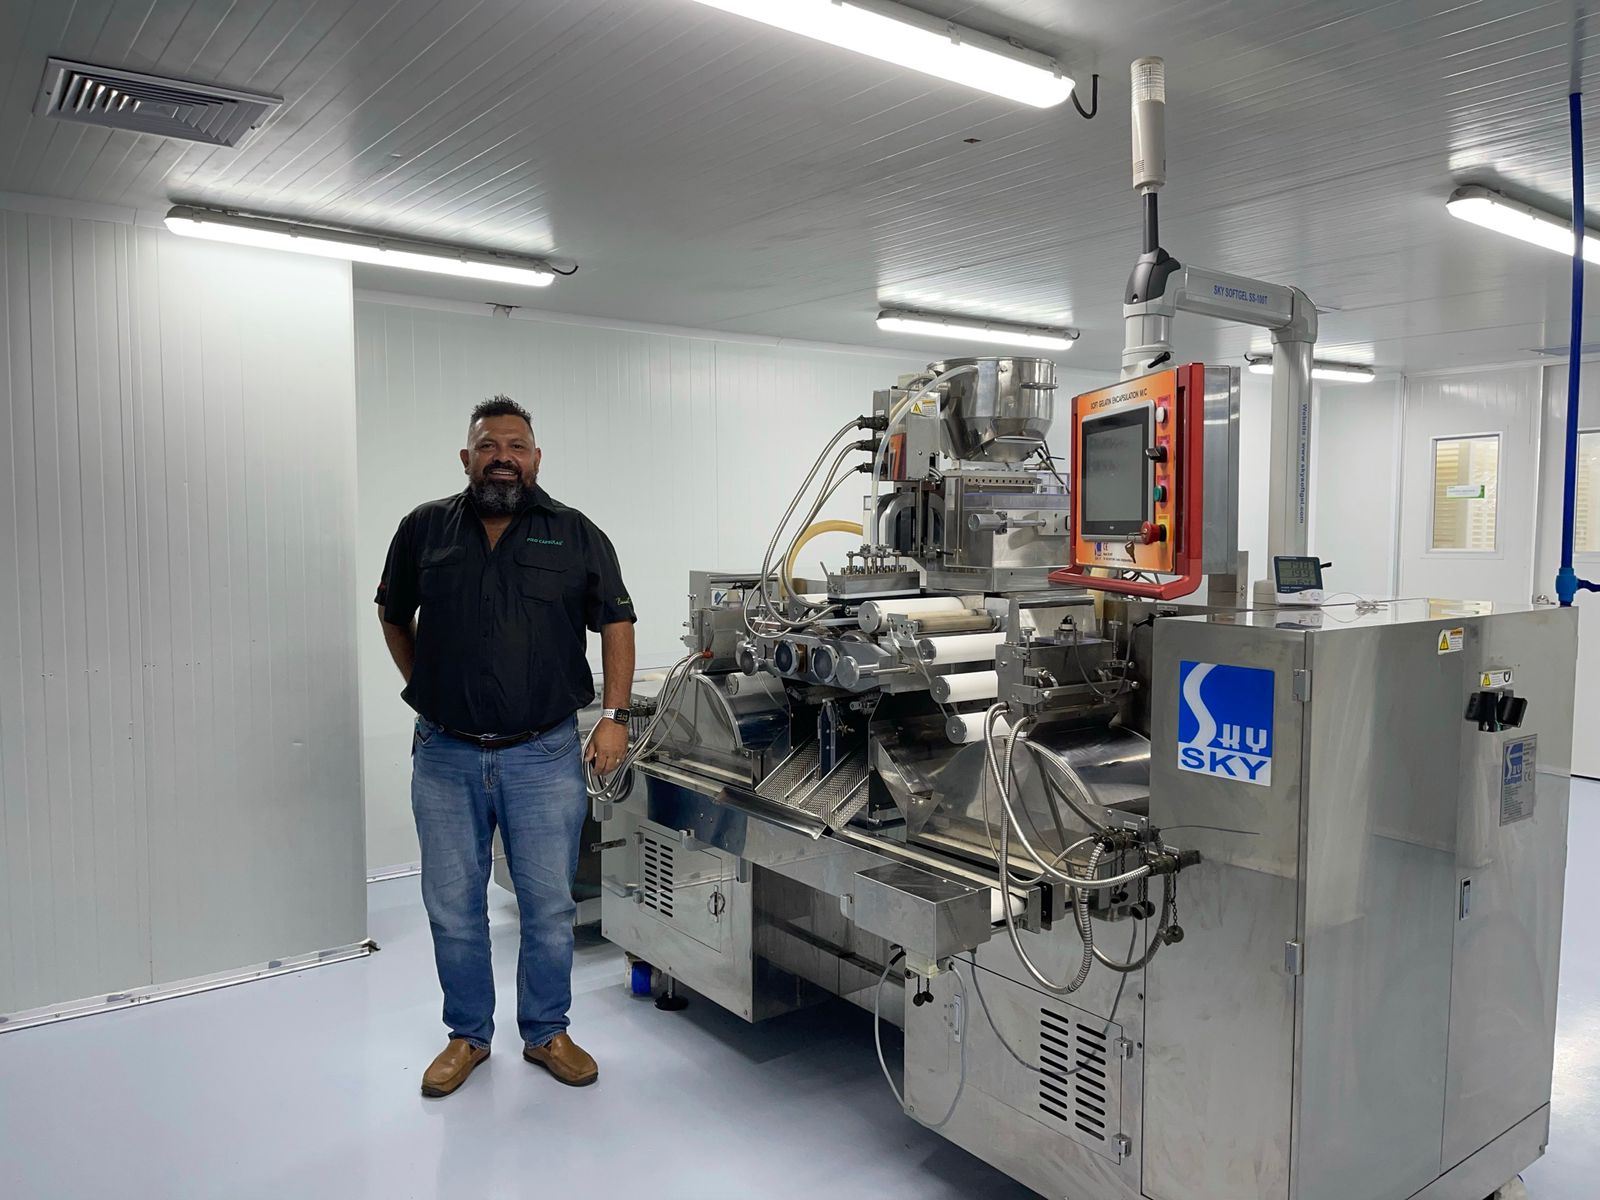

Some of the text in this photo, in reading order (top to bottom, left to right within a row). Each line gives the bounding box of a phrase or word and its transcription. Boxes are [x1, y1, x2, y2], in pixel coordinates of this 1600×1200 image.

[1213, 284, 1225, 297] SKY
[1225, 287, 1248, 302] SOFTGEL
[1181, 747, 1268, 780] SKY
